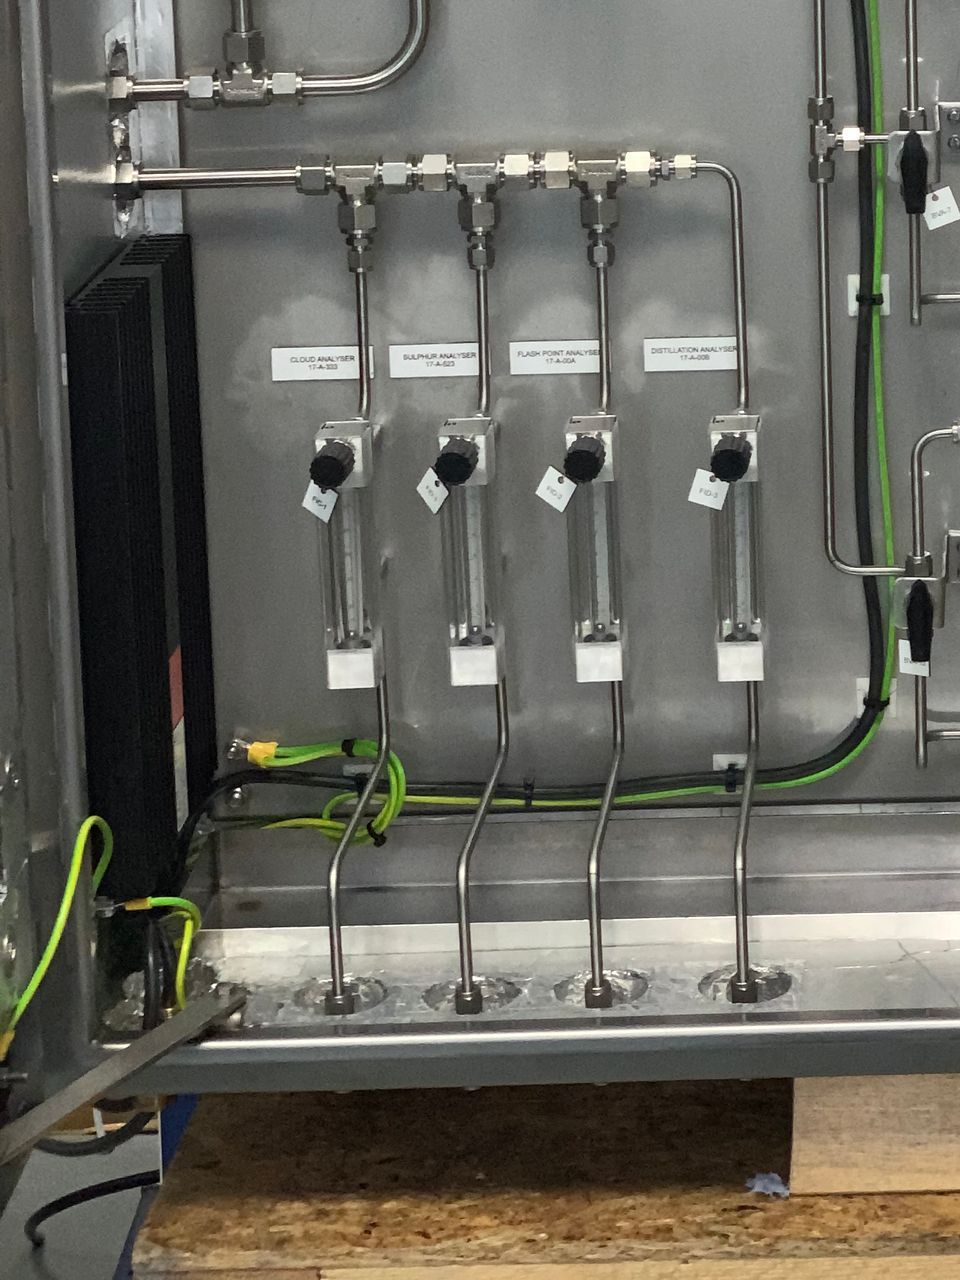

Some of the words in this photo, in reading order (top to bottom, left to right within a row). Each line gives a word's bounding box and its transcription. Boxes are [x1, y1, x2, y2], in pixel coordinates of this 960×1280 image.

[517, 350, 541, 358] FLASH
[565, 348, 601, 356] ANALYSE
[651, 346, 699, 354] DISTILLATION
[403, 353, 437, 361] SULPHUR
[439, 352, 477, 360] ANALYSER
